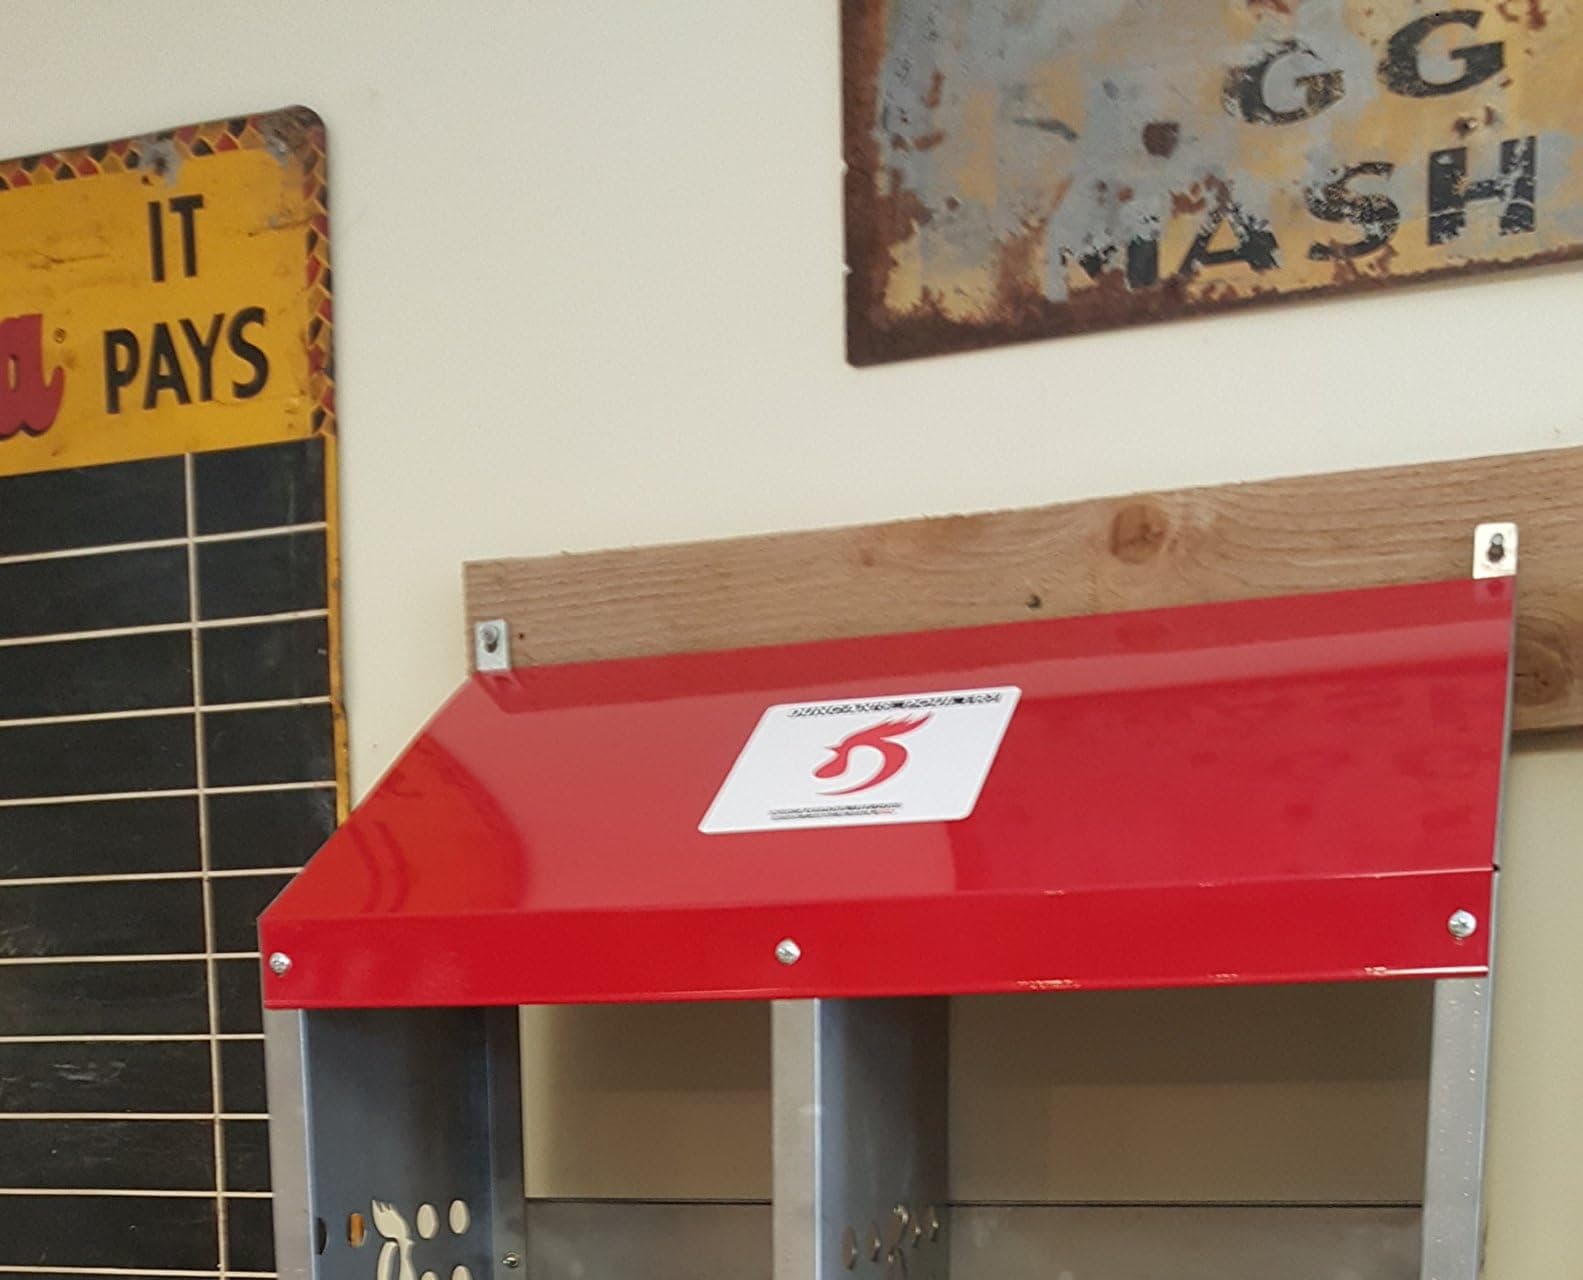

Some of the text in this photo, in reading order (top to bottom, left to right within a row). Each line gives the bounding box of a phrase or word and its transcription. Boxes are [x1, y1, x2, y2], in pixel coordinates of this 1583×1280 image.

[147, 193, 205, 283] IT
[1062, 136, 1537, 290] ASH
[103, 306, 269, 415] PAYS
